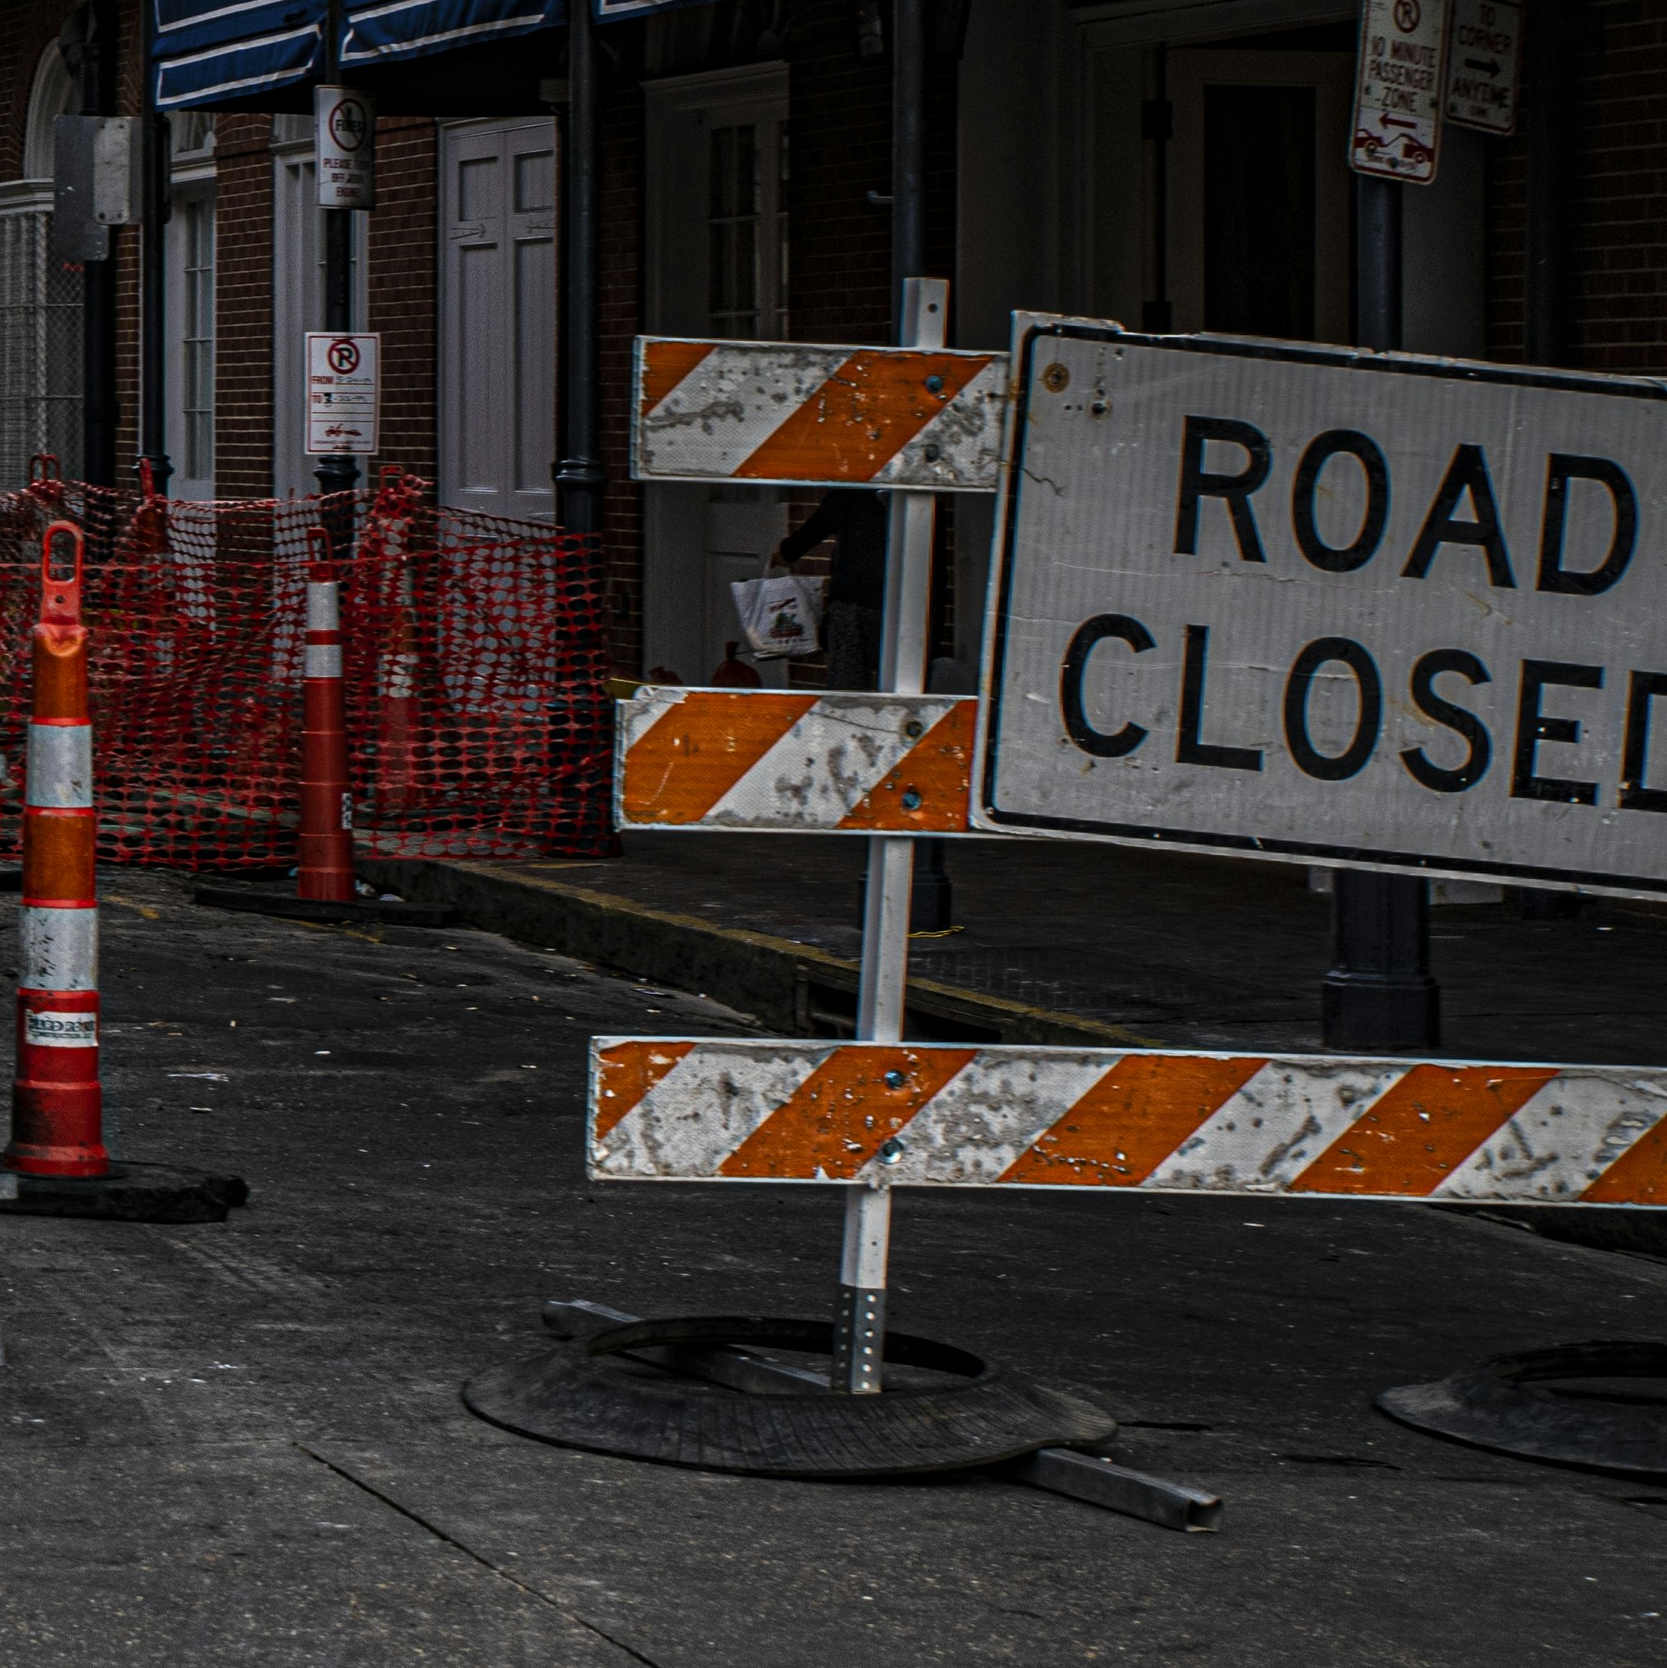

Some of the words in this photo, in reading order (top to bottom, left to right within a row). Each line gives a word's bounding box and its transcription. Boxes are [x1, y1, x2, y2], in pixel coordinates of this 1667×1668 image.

[1391, 40, 1437, 69] MINUTE
[1459, 25, 1511, 54] CORNER
[1369, 60, 1433, 90] PASSENGER
[1453, 79, 1509, 109] ANYTIME
[1174, 413, 1640, 596] ROAD
